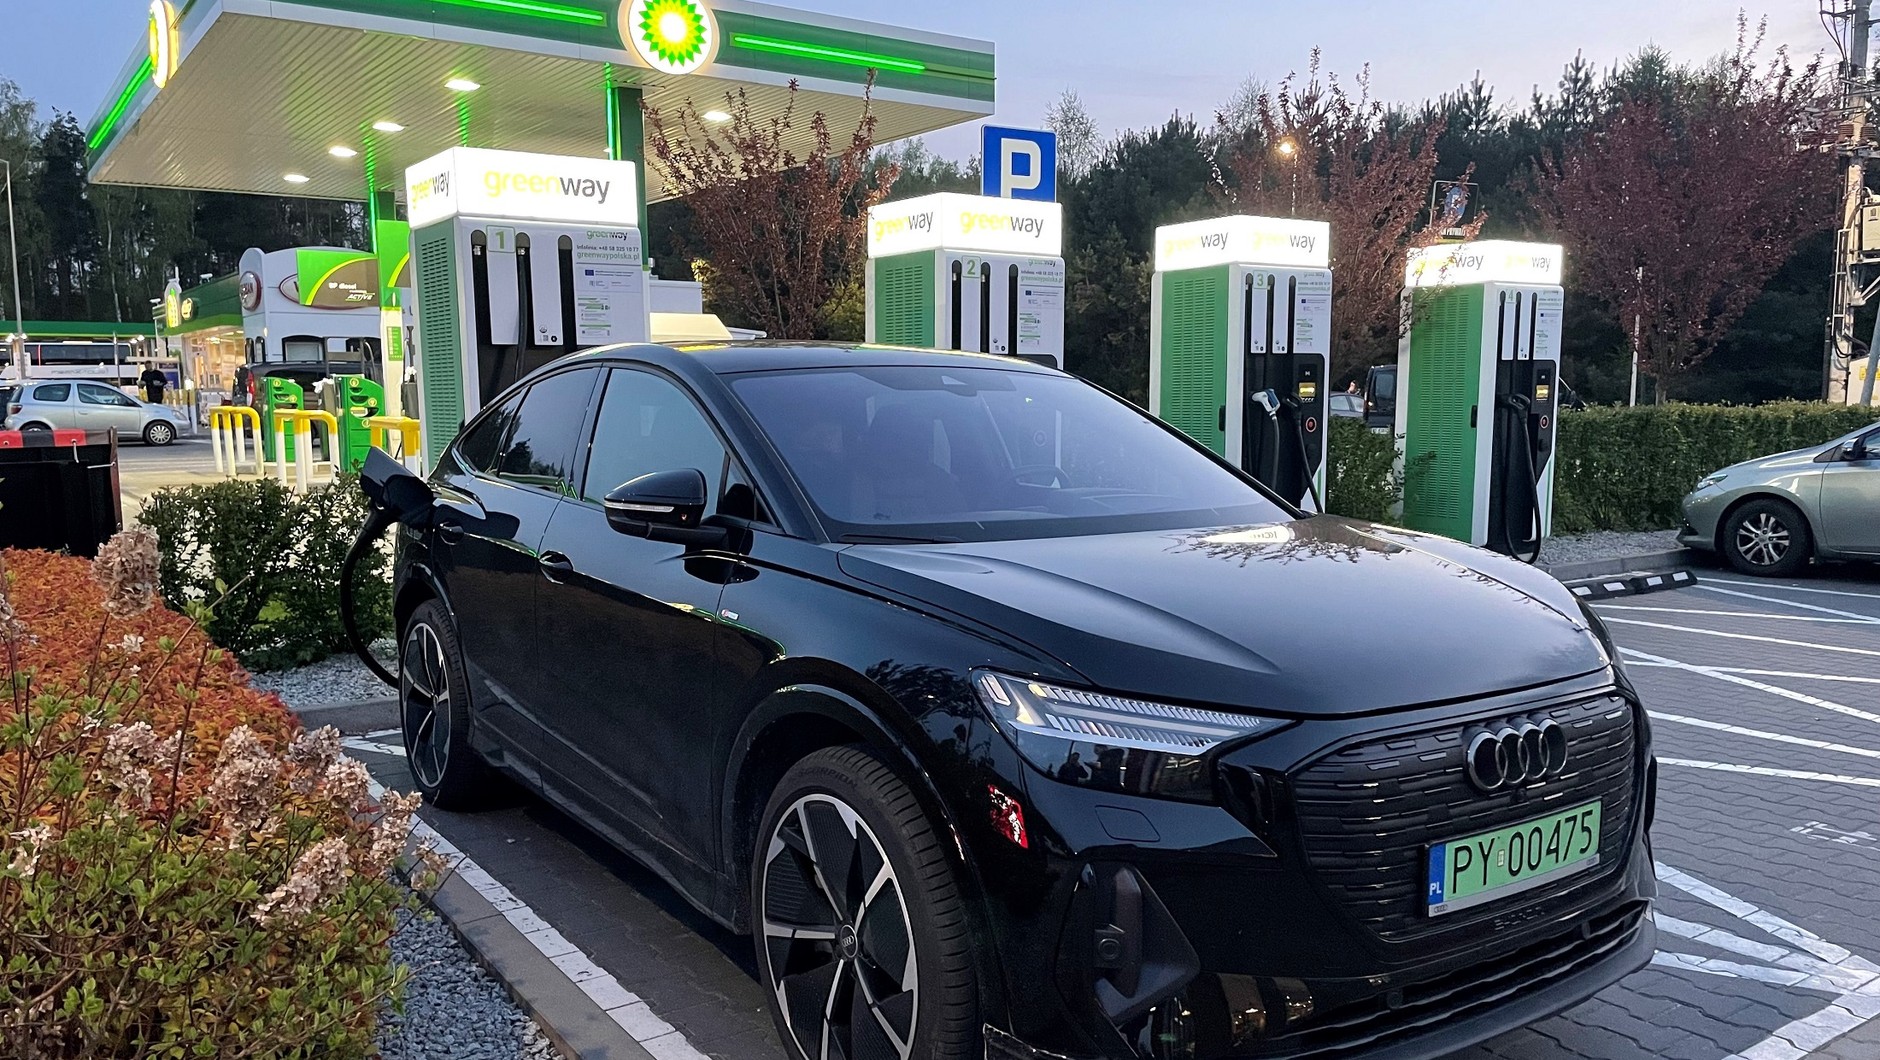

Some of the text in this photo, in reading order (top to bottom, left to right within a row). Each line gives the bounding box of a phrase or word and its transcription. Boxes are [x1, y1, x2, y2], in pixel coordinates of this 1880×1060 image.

[1000, 137, 1042, 199] P
[411, 170, 450, 210] greenway
[483, 169, 610, 205] greenway
[874, 211, 934, 242] greenway
[960, 210, 1045, 239] greenway
[495, 231, 505, 249] 1
[586, 229, 628, 241] greenway
[576, 251, 640, 261] greenwaypolska.pl
[966, 259, 976, 276] 2
[1257, 272, 1265, 287] 3
[1508, 288, 1514, 301] 4
[1508, 809, 1594, 877] 00475
[1429, 882, 1442, 896] PL
